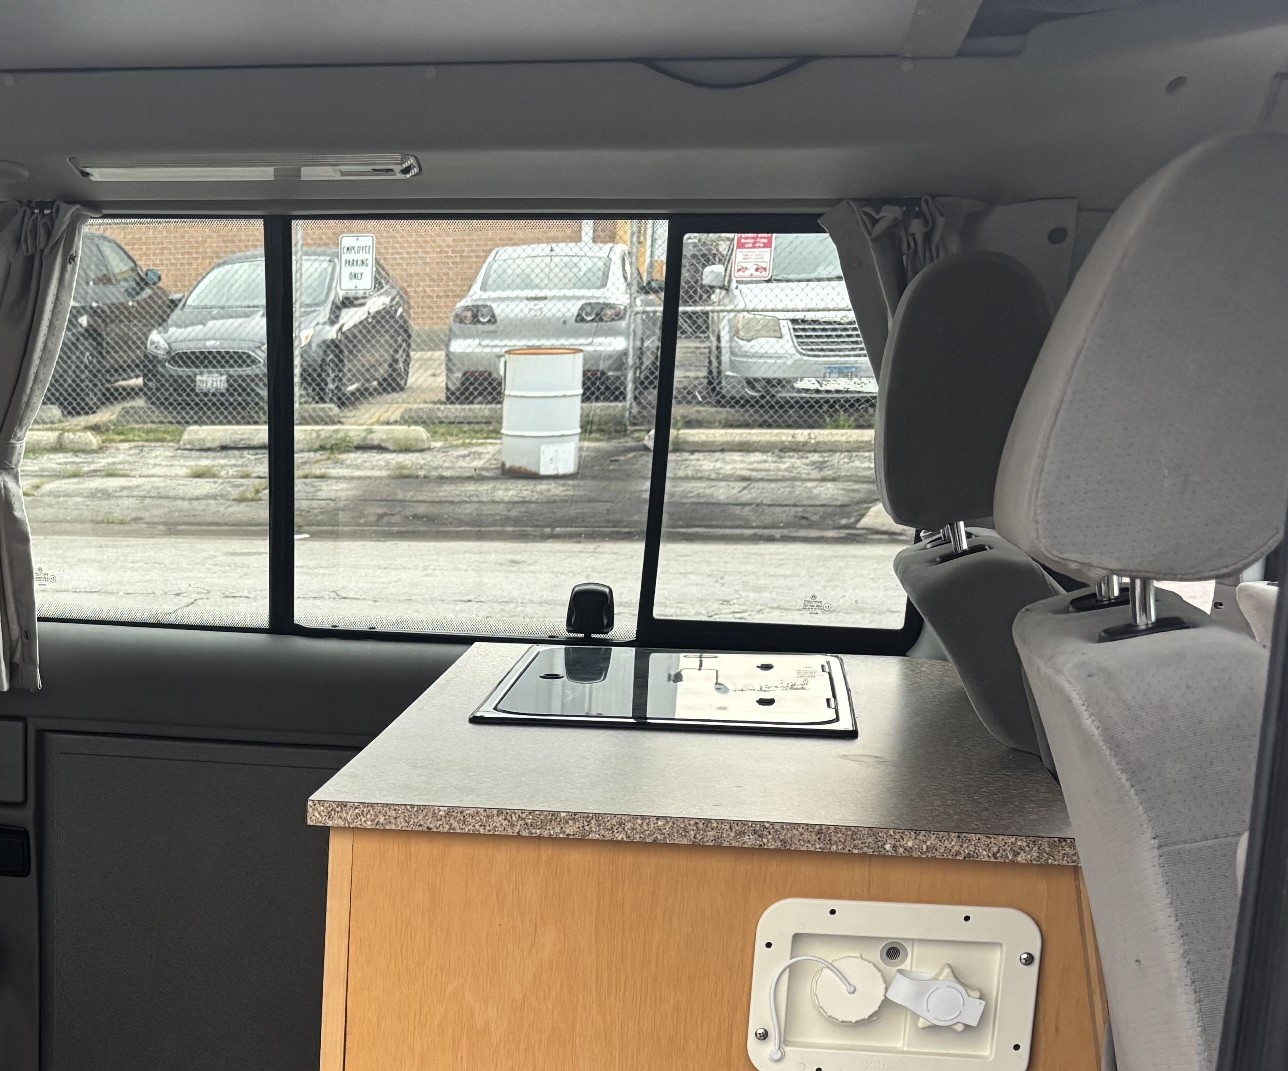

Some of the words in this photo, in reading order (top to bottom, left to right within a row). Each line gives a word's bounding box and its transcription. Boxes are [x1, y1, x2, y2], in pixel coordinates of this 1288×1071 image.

[342, 245, 371, 255] EMPLOYEE
[344, 258, 368, 268] PARKING
[349, 271, 363, 281] ONLY
